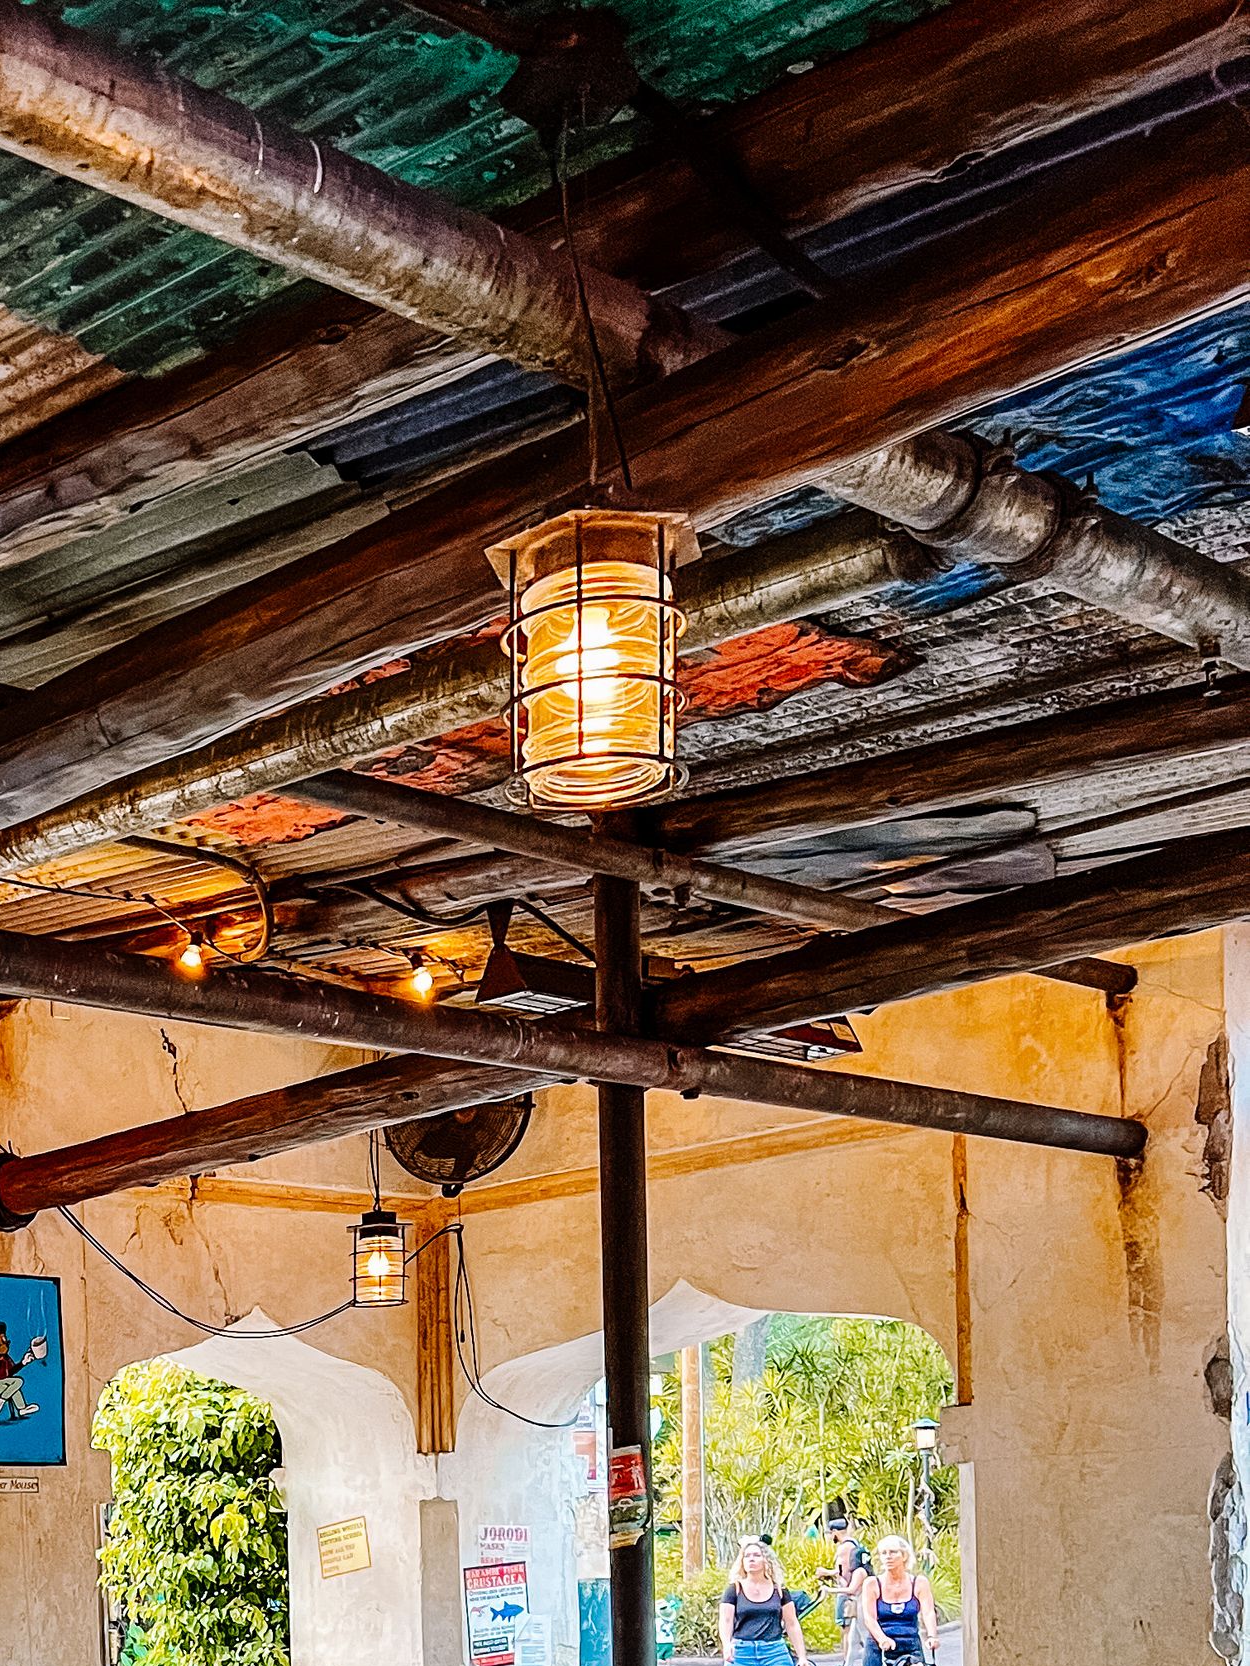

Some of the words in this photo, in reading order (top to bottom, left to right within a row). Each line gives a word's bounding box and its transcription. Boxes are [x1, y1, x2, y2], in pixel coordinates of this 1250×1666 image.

[9, 1479, 37, 1491] Mouse
[479, 1526, 528, 1542] JORODI
[466, 1573, 524, 1590] CRUSTACEA
